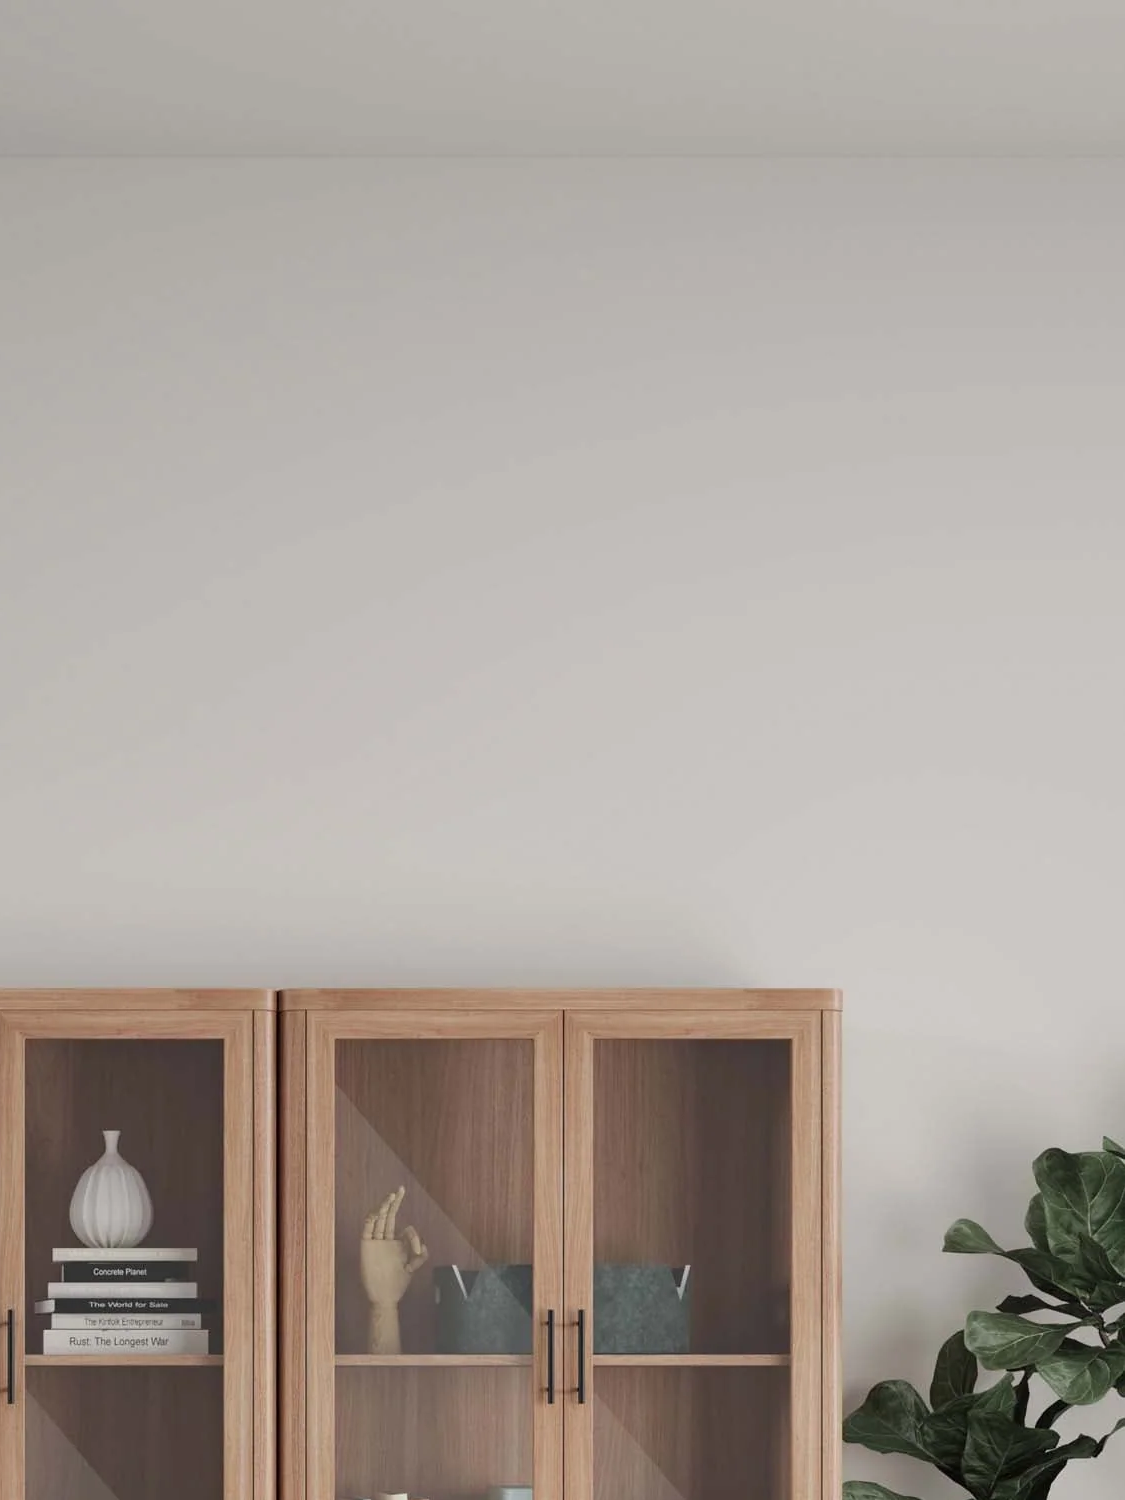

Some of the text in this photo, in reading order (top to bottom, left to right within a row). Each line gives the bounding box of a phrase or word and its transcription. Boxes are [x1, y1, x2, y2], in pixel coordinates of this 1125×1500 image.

[93, 1267, 147, 1276] Concrete Planet
[84, 1318, 97, 1326] The
[121, 1318, 163, 1327] Entrepreneur
[95, 1337, 111, 1346] The
[114, 1337, 149, 1348] Longest
[151, 1337, 169, 1346] War
